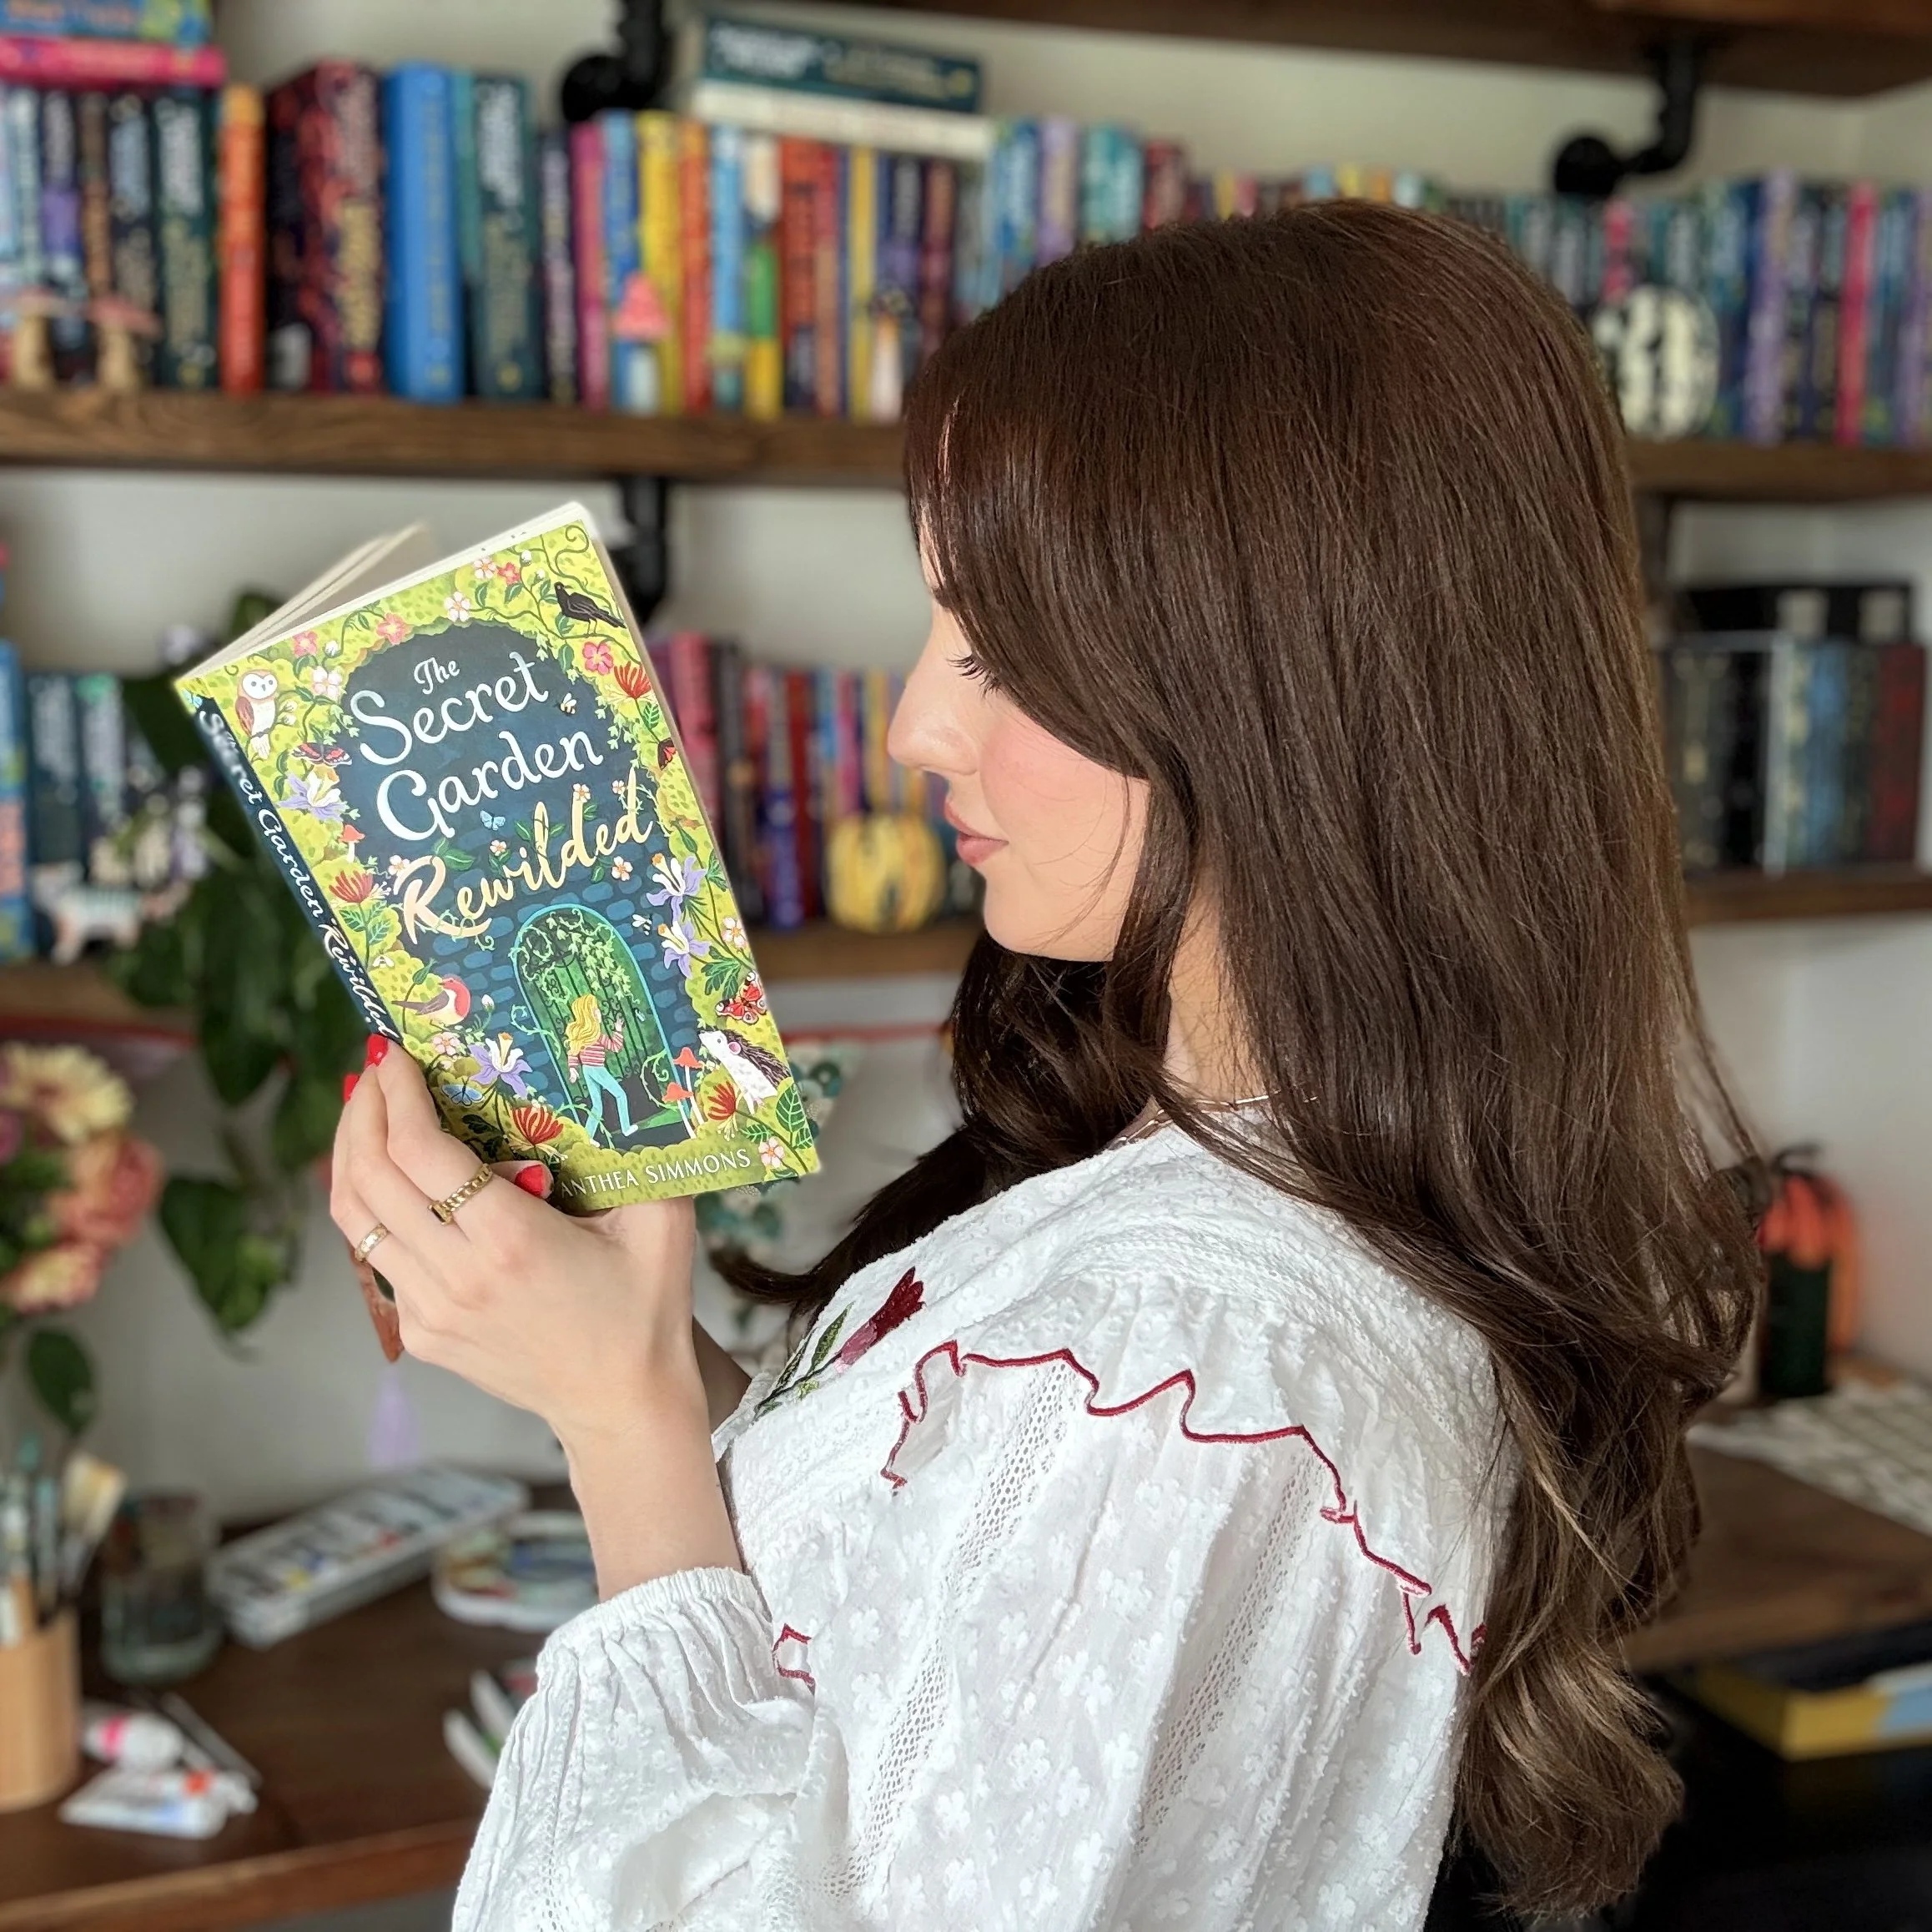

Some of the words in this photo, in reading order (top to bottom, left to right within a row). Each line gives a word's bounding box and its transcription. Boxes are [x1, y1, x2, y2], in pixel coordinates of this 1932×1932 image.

[350, 651, 549, 766] Secret
[414, 657, 460, 695] The
[376, 730, 604, 842] Garden
[199, 710, 263, 805] Sret
[257, 808, 324, 918] Garden
[317, 923, 400, 1039] Rewilded
[393, 766, 654, 945] Rewilded
[560, 1170, 640, 1199] ANTHEA
[645, 1148, 752, 1185] SIMMONS
